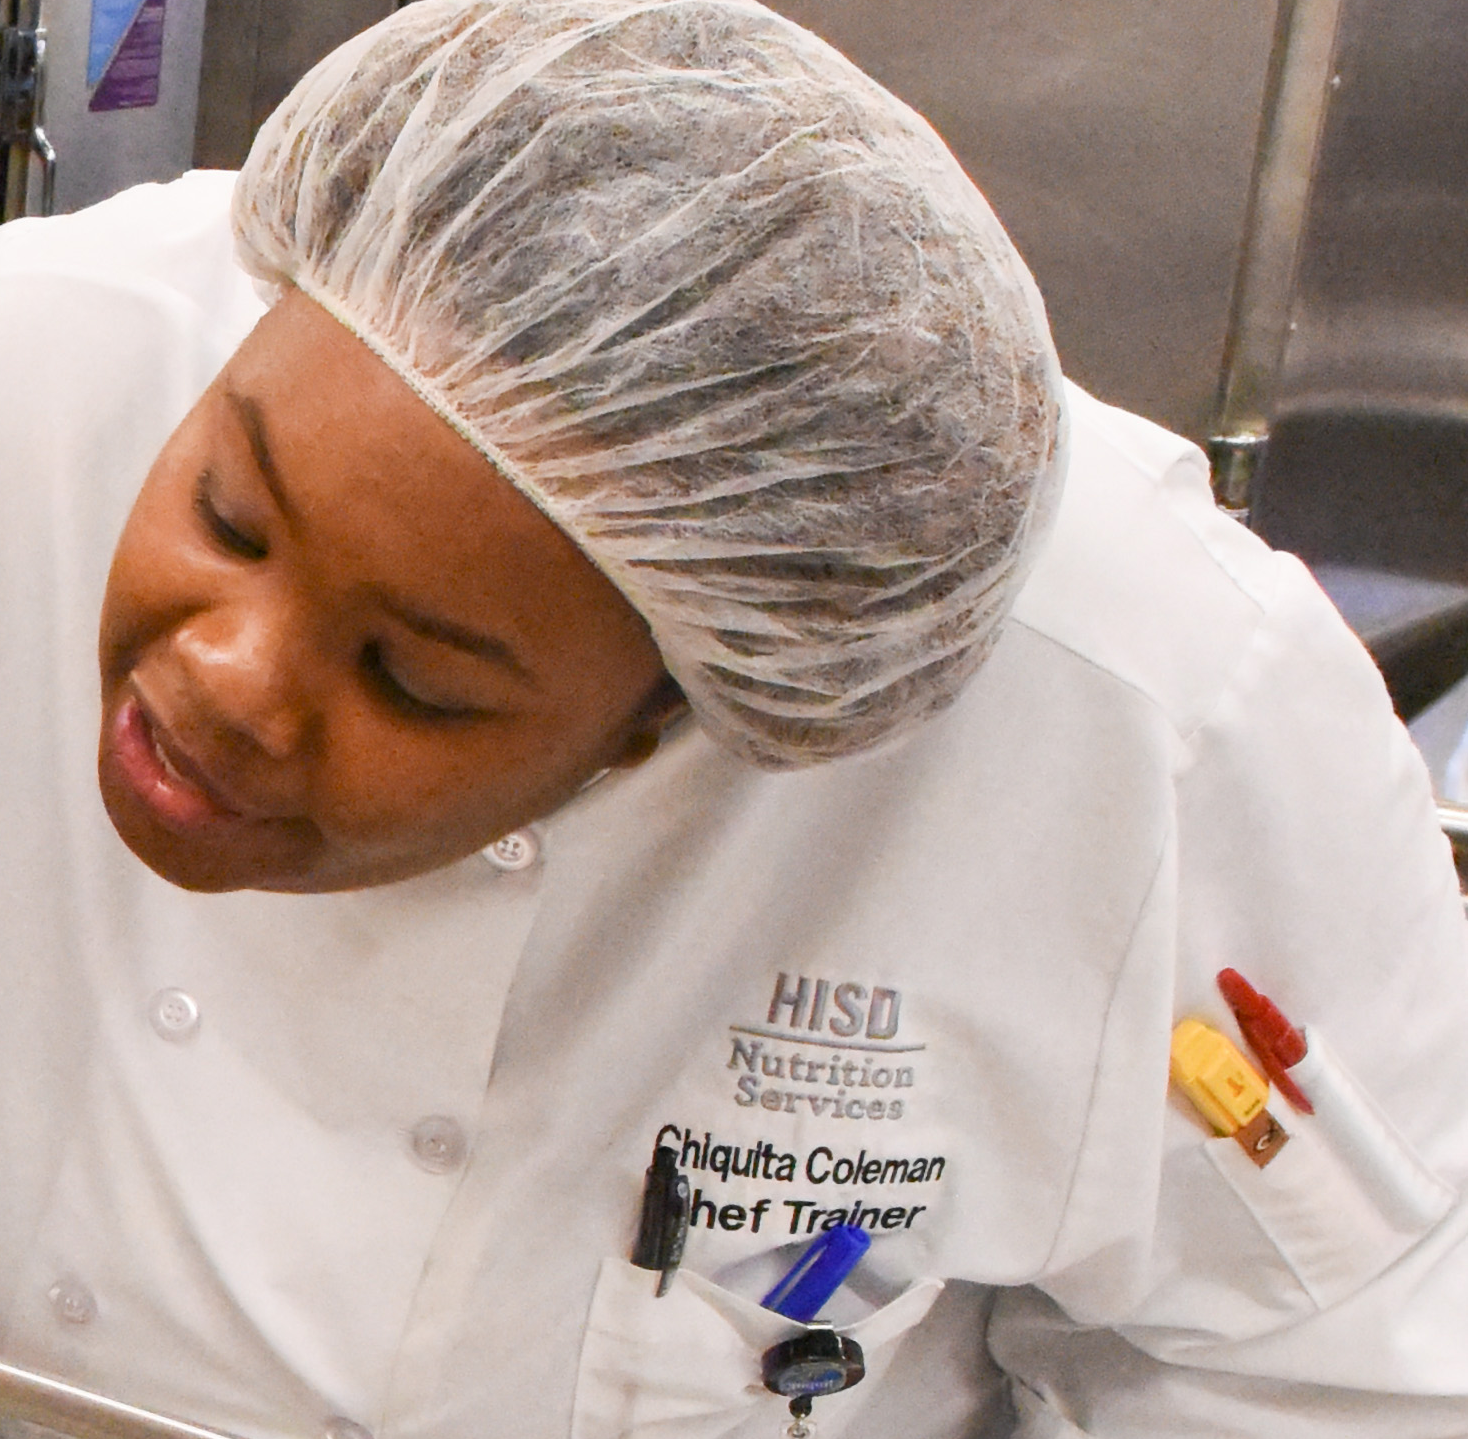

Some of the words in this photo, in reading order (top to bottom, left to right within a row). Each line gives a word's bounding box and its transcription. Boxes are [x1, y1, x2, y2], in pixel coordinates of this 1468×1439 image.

[767, 971, 902, 1040] HISD
[726, 1036, 915, 1088] Nutrition
[734, 1073, 906, 1121] Services
[806, 1146, 946, 1186] Coleman
[783, 1199, 927, 1235] Trainer
